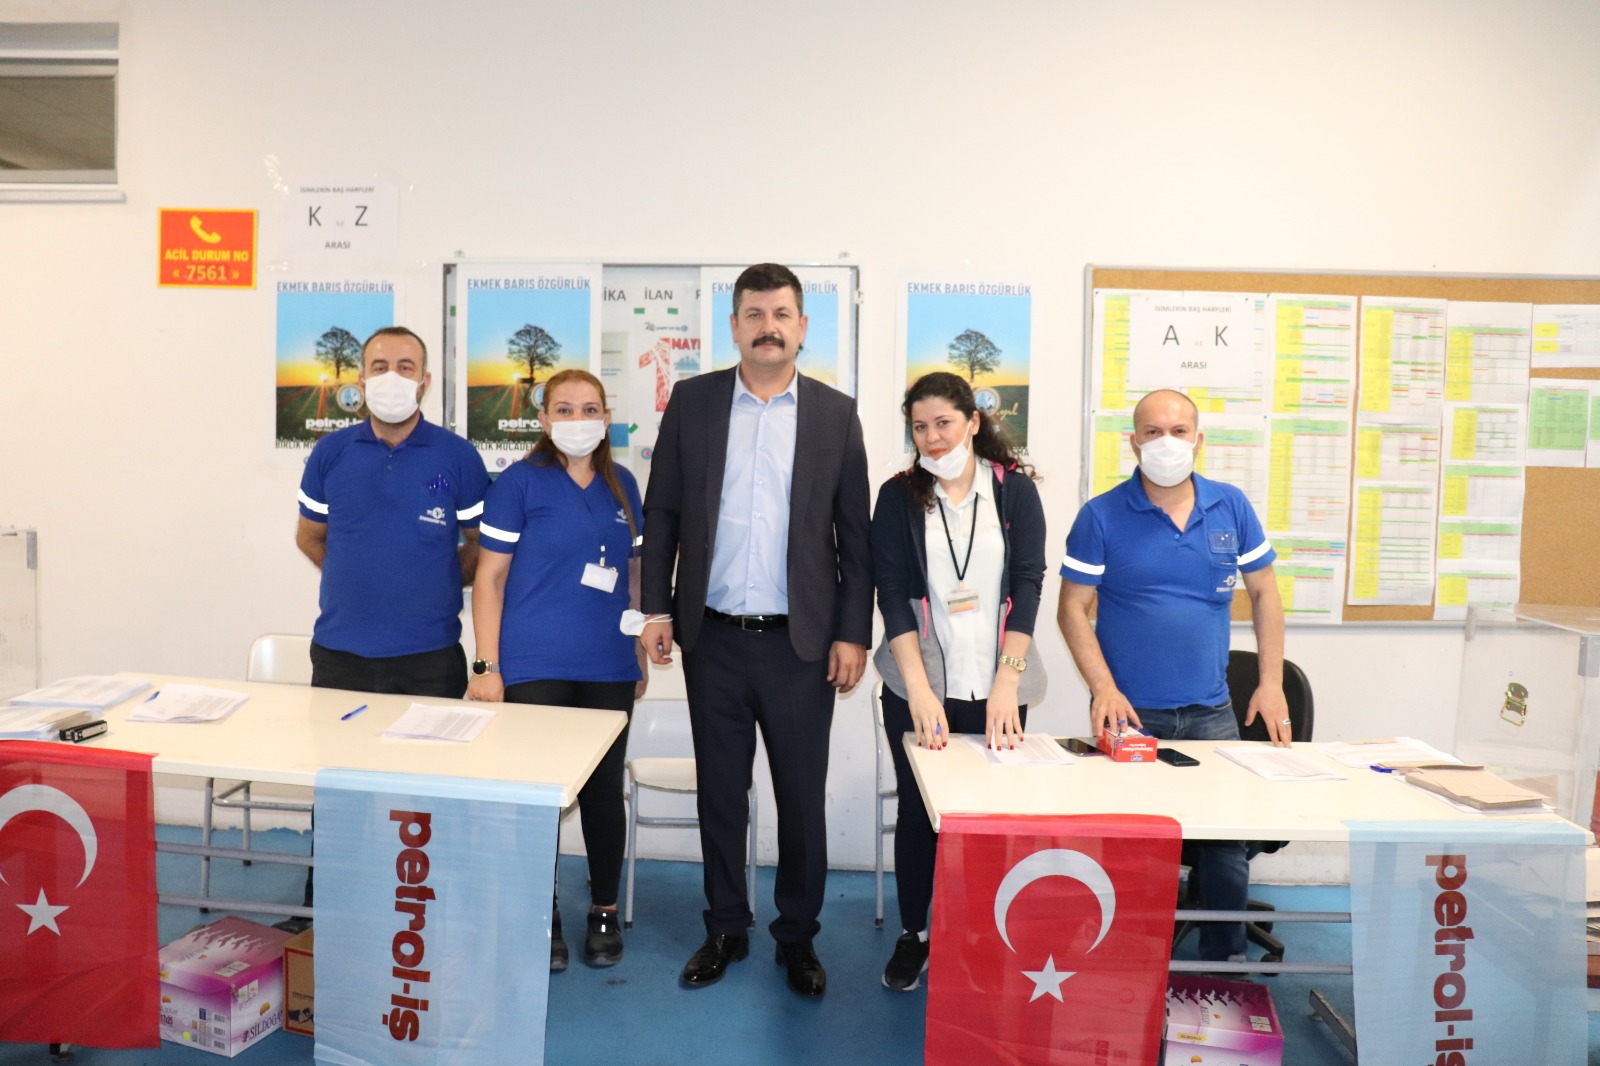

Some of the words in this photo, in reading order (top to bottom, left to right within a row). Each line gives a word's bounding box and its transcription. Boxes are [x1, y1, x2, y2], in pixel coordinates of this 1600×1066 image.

[308, 205, 322, 226] K
[354, 205, 368, 226] Z
[324, 241, 351, 249] ARASI
[165, 247, 189, 261] ACİL
[192, 248, 230, 262] DURUM
[233, 250, 249, 261] NO
[186, 264, 227, 281] 7561
[277, 281, 309, 292] EKMEK
[343, 279, 394, 293] ÖZGÜRLÜK
[467, 278, 501, 290] EKMEK
[537, 276, 591, 290] ÖZGÜRLÜK
[711, 282, 735, 293] EKM
[803, 280, 838, 294] ÜRLÜK
[907, 281, 942, 294] EKMEK
[978, 281, 1032, 297] ÖZGÜRLÜK
[602, 286, 627, 301] İKA
[644, 286, 673, 300] İLAN
[1162, 325, 1180, 346] A
[1215, 325, 1228, 347] K
[1180, 361, 1207, 370] ARASI
[305, 417, 364, 430] petrol-i
[498, 417, 543, 430] petro
[495, 438, 538, 451] MÜCADEL
[382, 810, 436, 1042] petrol-iş
